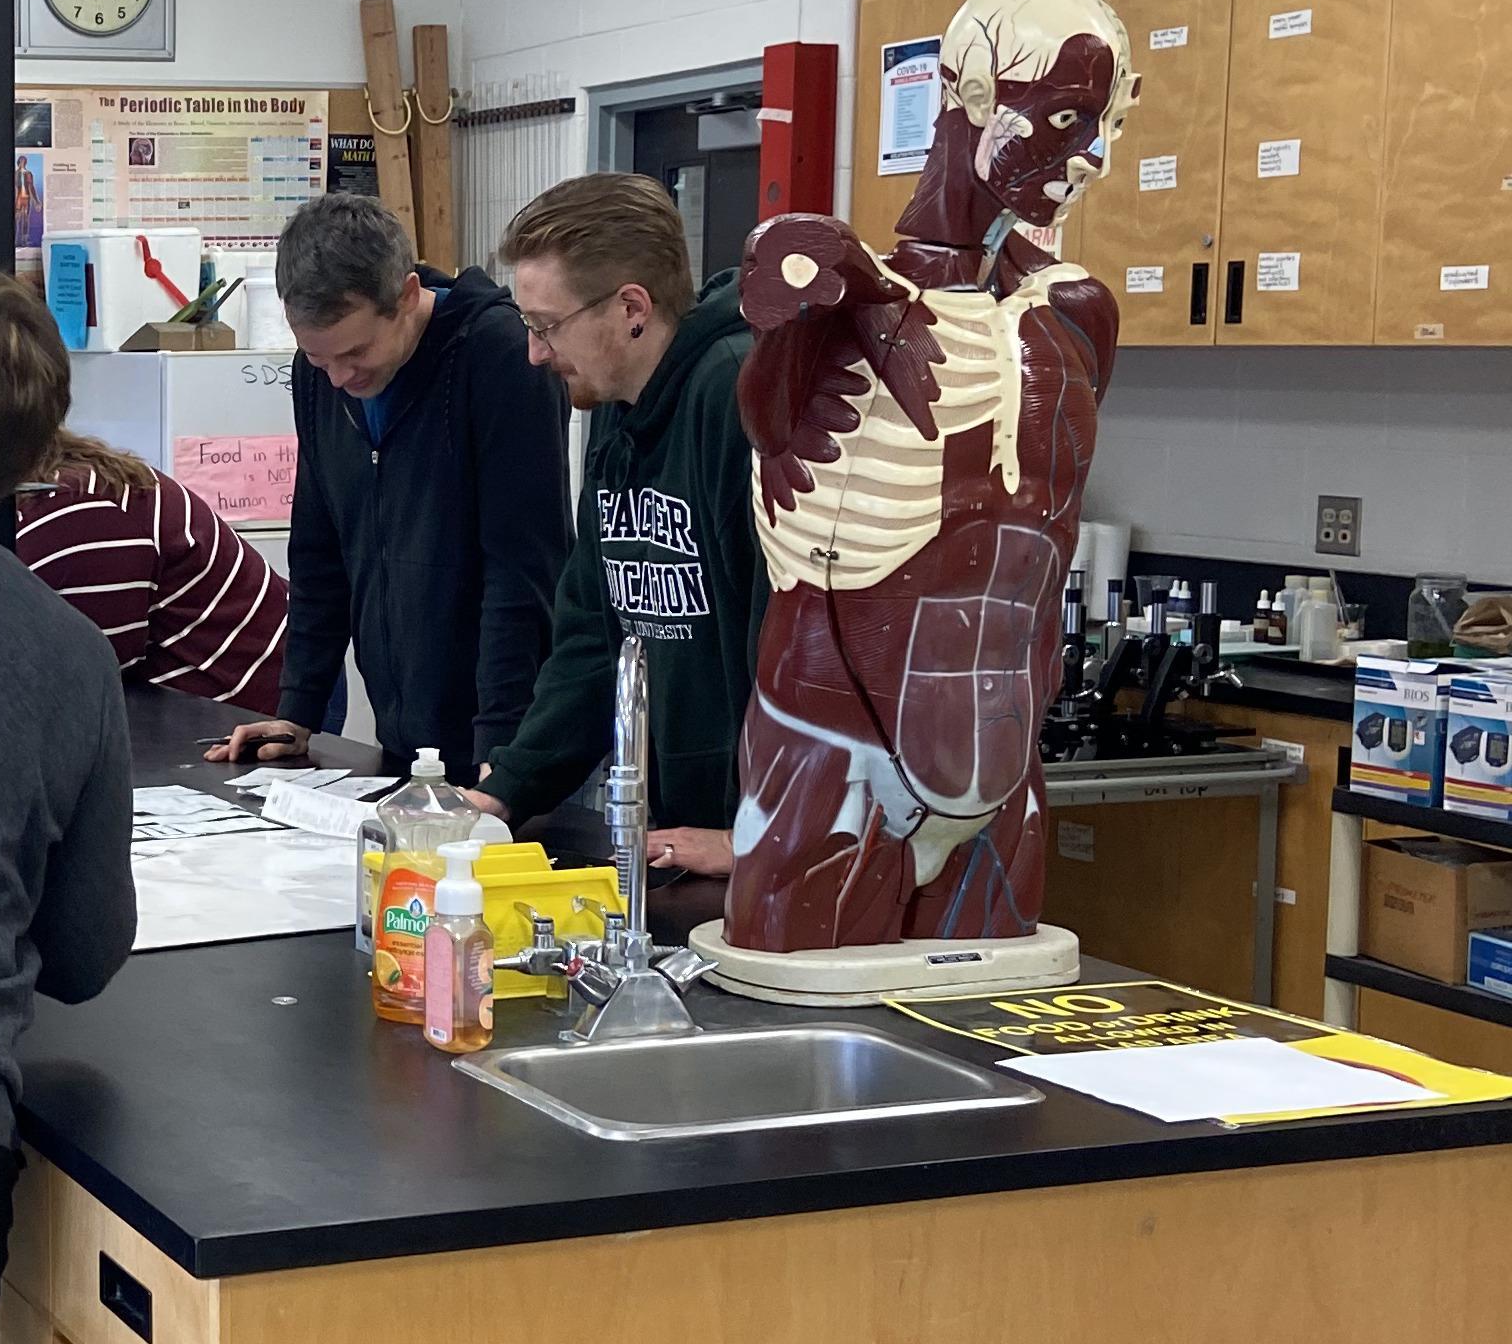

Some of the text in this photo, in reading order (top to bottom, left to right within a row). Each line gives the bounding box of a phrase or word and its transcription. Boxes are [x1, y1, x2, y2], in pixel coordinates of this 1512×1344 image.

[74, 6, 82, 18] 7
[95, 12, 104, 25] 6
[118, 7, 126, 19] 5
[99, 96, 306, 115] The Periodic Table in the Body
[330, 138, 359, 149] WHAT
[341, 150, 370, 162] MATH
[199, 440, 296, 465] Food in th
[243, 467, 293, 483] is NOT
[217, 491, 268, 511] human
[1403, 688, 1430, 702] BIOS
[386, 910, 429, 936] Palmol
[989, 994, 1126, 1019] NO
[972, 1006, 1250, 1039] FOOD or DRINK
[1053, 1022, 1238, 1044] ALLOWED IN
